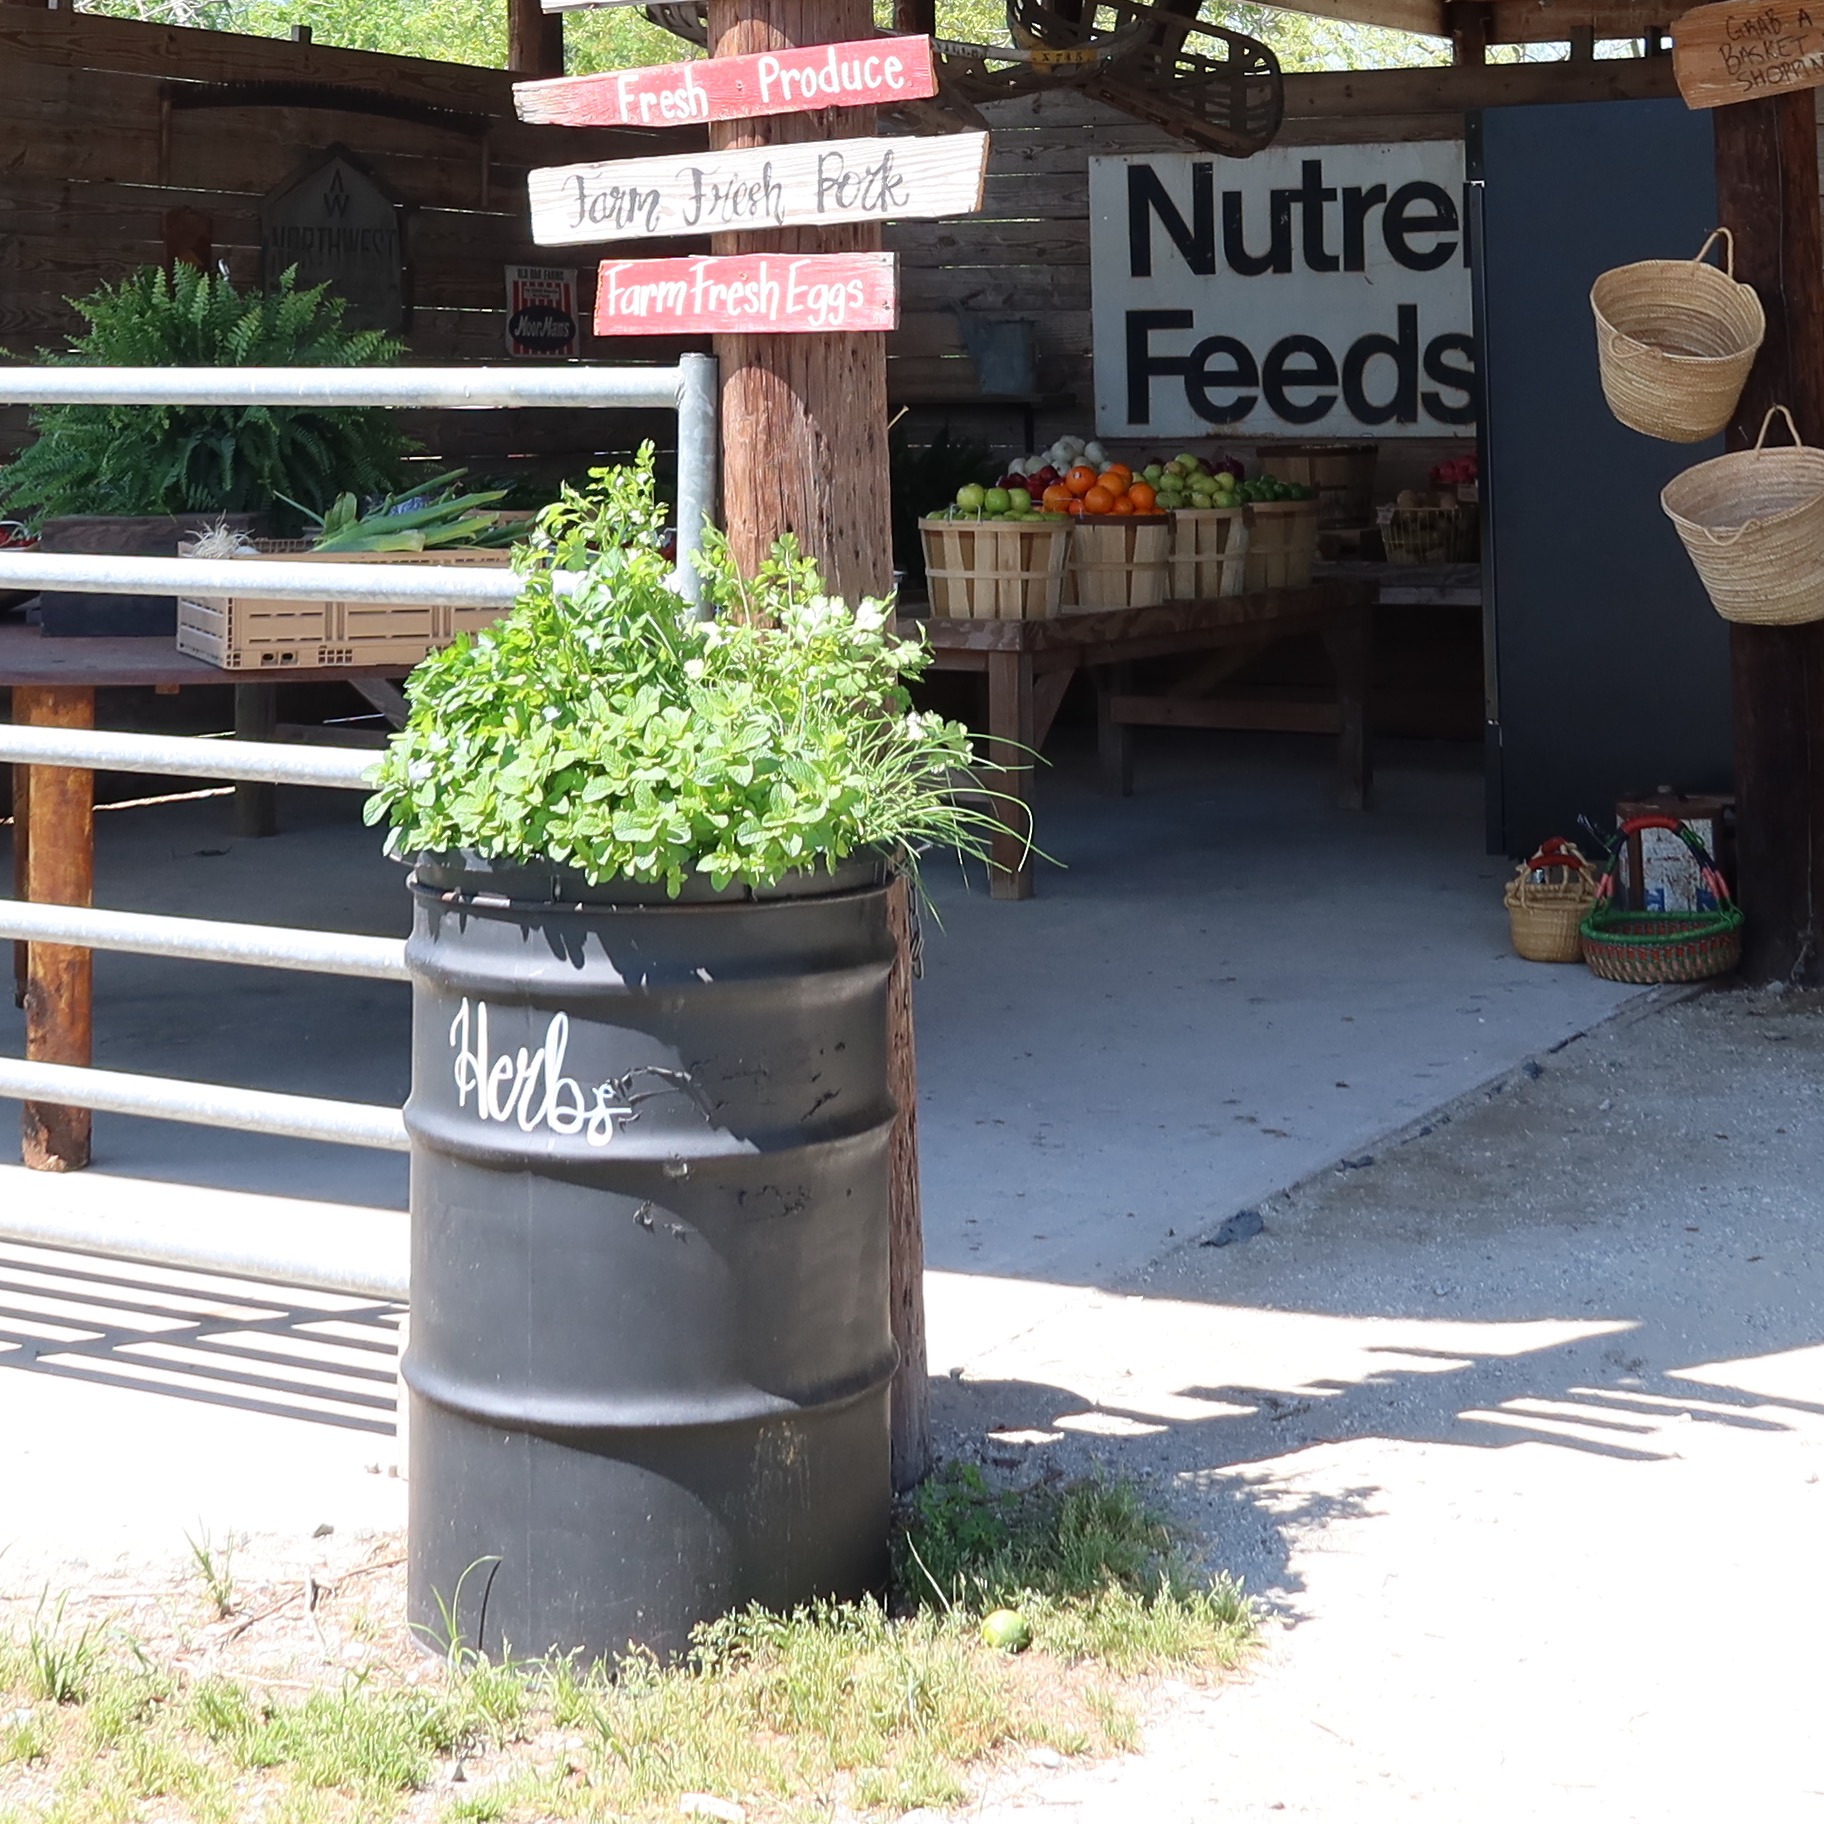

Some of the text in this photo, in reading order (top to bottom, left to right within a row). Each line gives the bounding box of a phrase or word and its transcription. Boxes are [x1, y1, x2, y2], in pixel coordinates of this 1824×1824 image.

[1718, 34, 1809, 75] BASKET
[1798, 8, 1814, 28] A
[616, 45, 905, 124] Fresh Produce
[561, 149, 911, 233] Farm Fresh Pork
[1126, 159, 1472, 278] Nutre
[605, 258, 866, 329] Farm Fresh Eggs
[1124, 303, 1478, 426] Feeds
[449, 996, 633, 1148] Herbs
